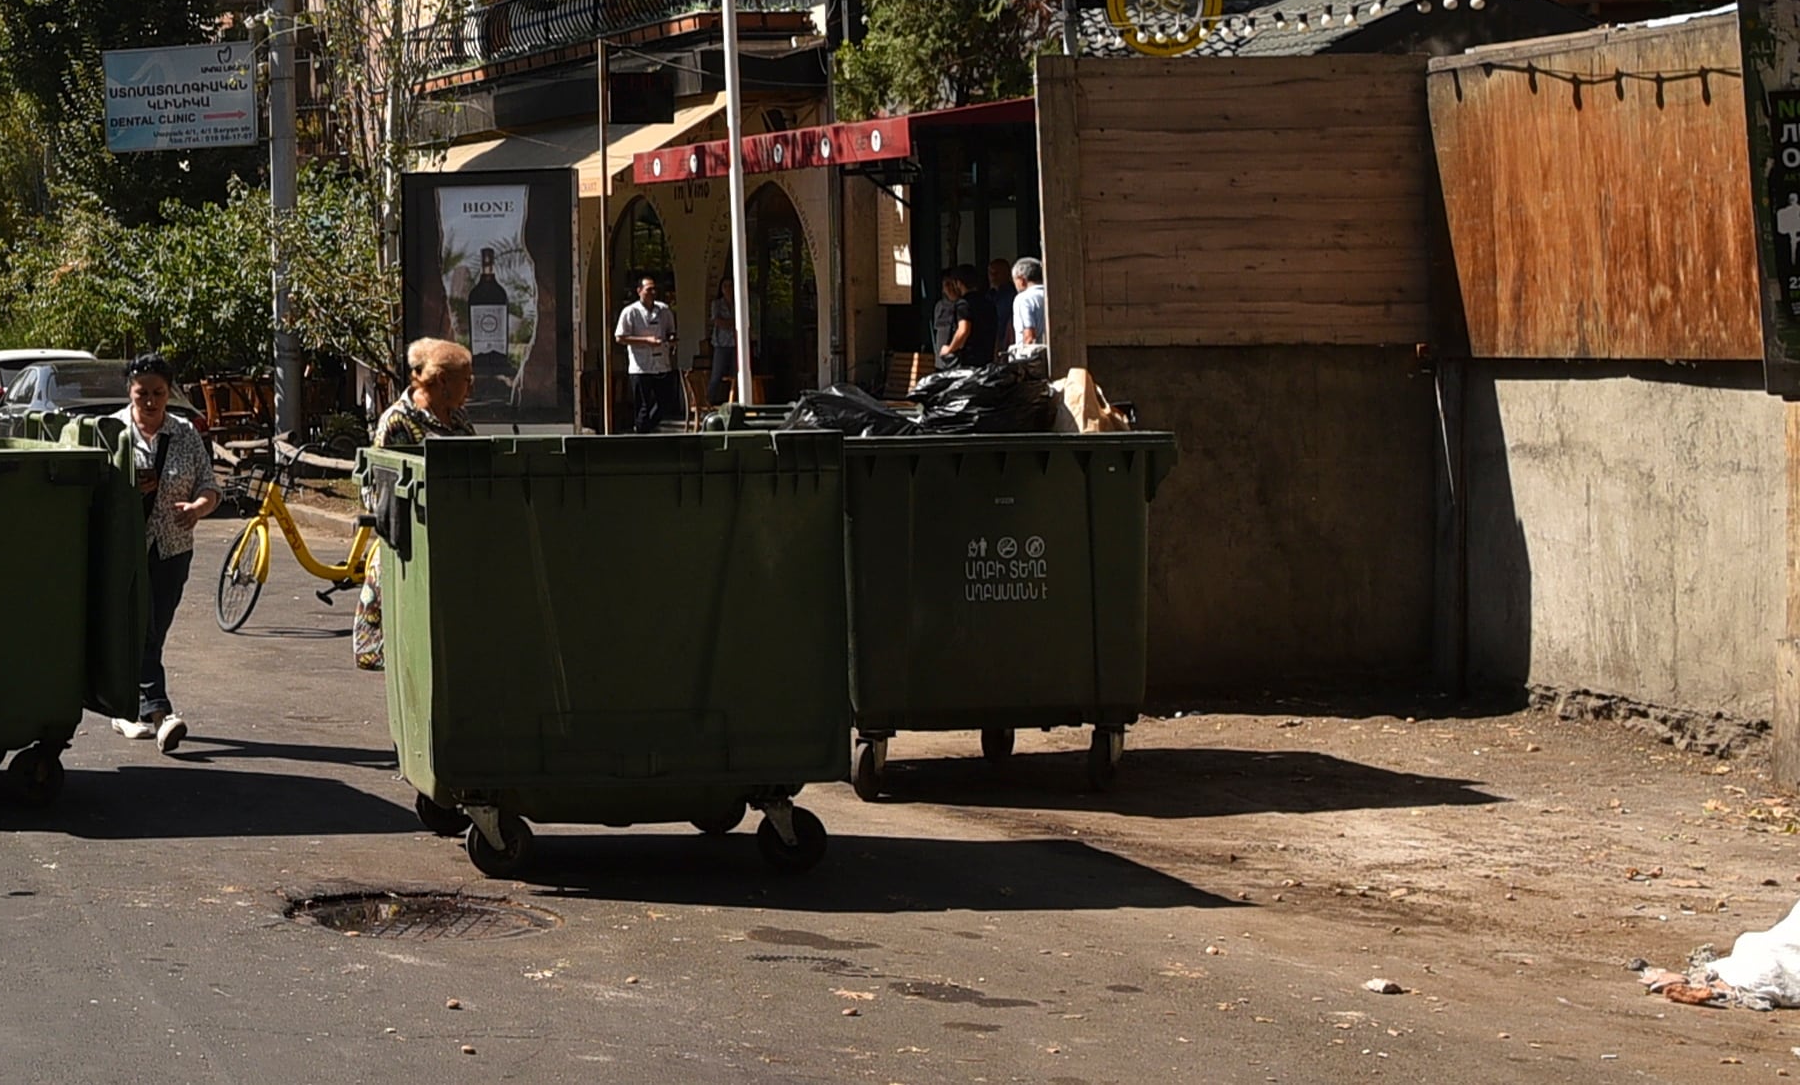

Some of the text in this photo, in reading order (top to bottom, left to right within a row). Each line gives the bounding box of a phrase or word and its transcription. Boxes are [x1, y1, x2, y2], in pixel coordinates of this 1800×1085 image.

[147, 96, 211, 111] ԿԼԻՆԻԿԱ
[1777, 99, 1800, 119] N
[110, 114, 197, 128] DENTAL CLINIC
[463, 201, 514, 213] BIONE
[965, 558, 1047, 580] ԱՂԲԻ ՏԵՂԸ
[1041, 582, 1049, 600] Է
